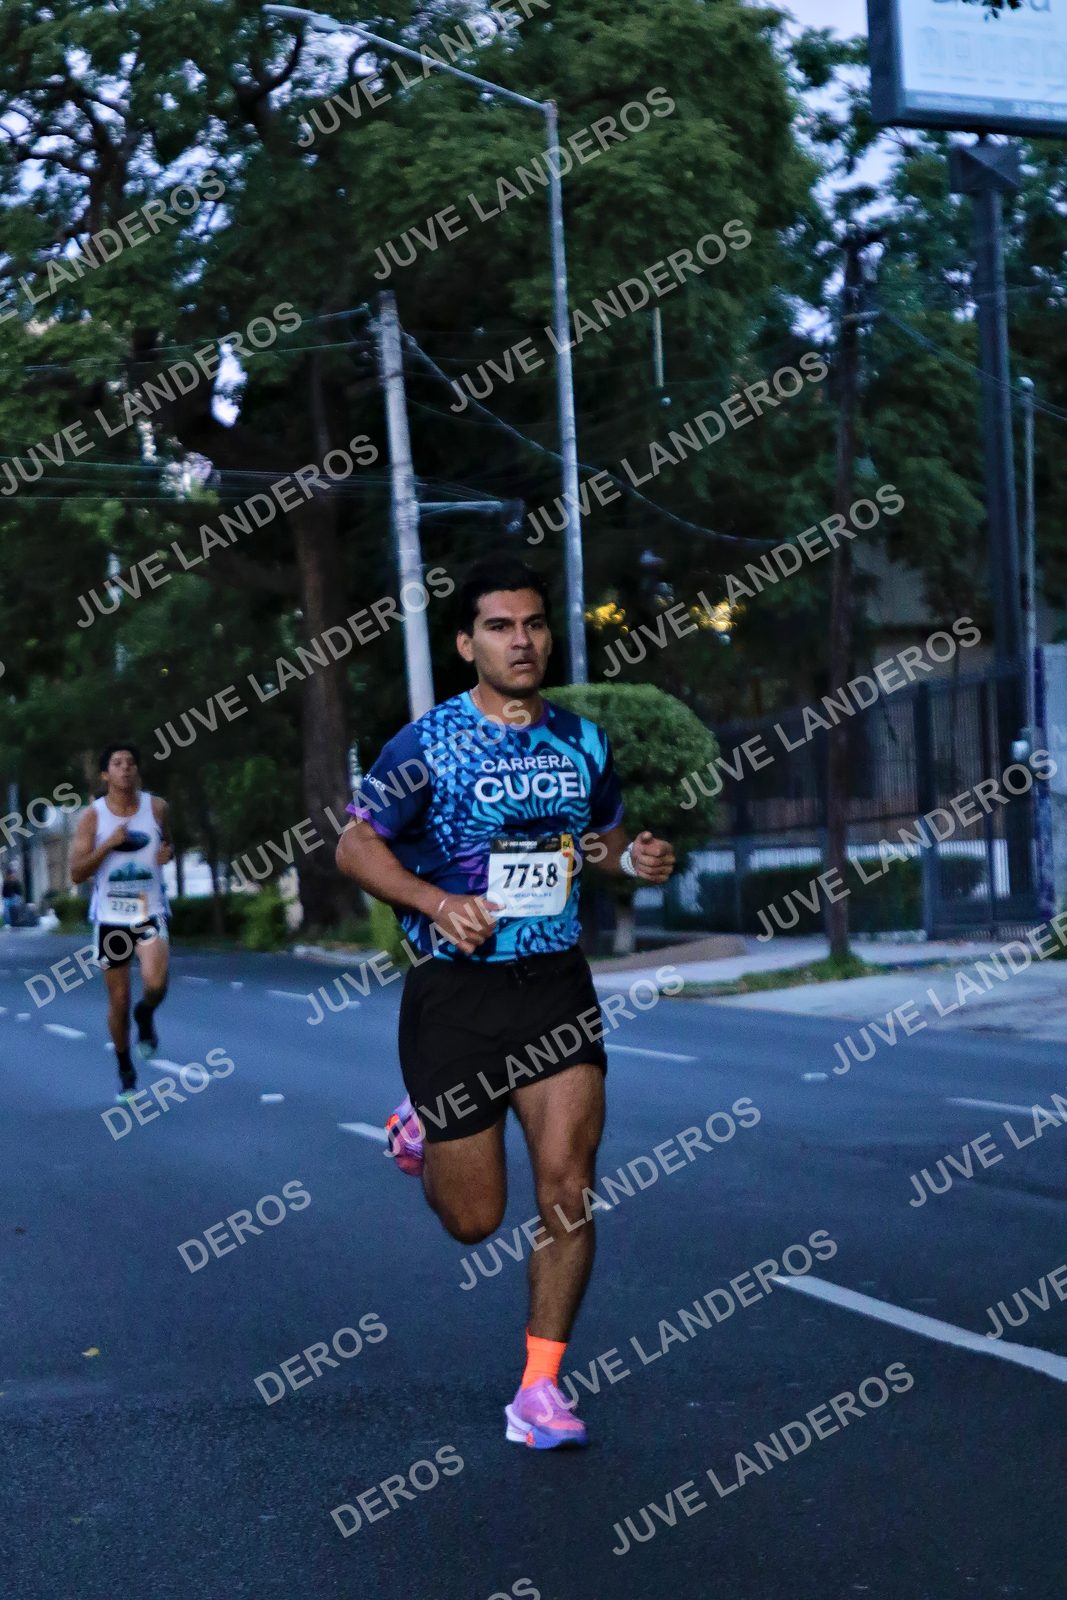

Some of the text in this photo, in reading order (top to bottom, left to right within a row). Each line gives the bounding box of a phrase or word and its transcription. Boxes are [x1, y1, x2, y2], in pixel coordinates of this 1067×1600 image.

[481, 755, 574, 773] CARRERA
[474, 771, 586, 803] CUCEI
[503, 862, 559, 888] 7758
